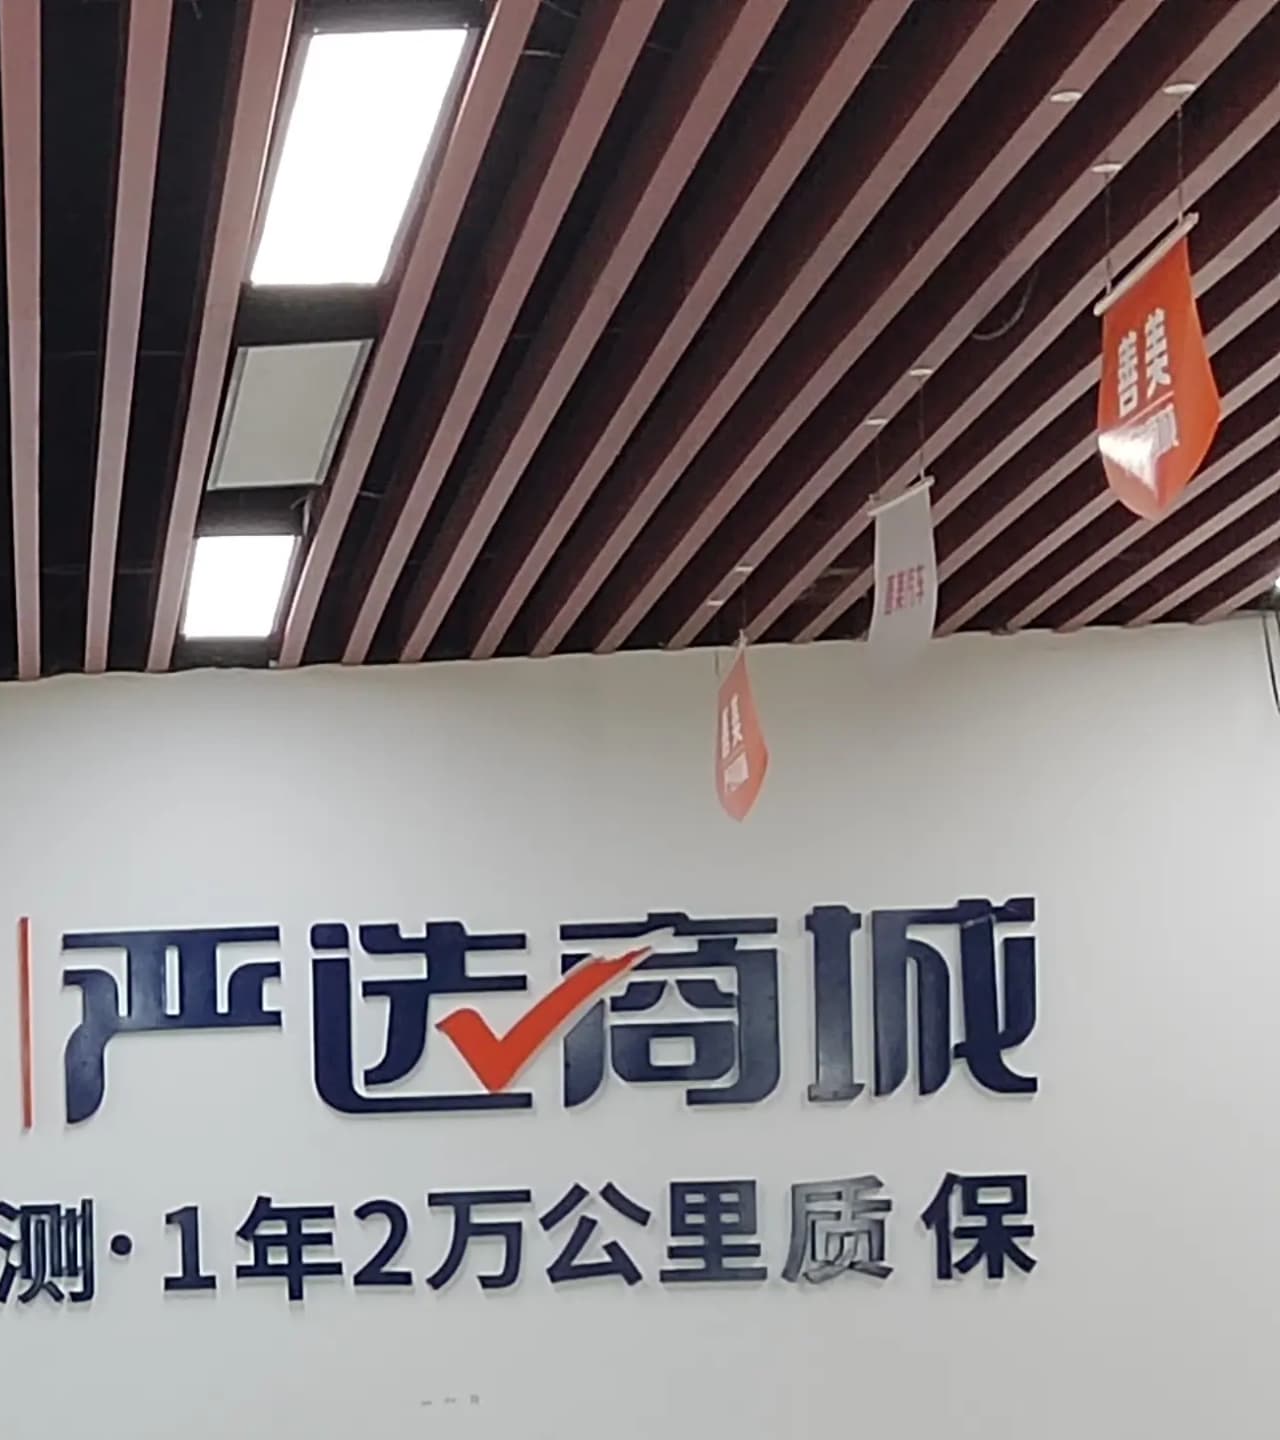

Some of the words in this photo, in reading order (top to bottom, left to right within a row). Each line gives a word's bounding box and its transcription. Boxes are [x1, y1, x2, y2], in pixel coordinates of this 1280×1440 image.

[1117, 307, 1172, 418] 善美
[61, 896, 1039, 1126] 严选商城
